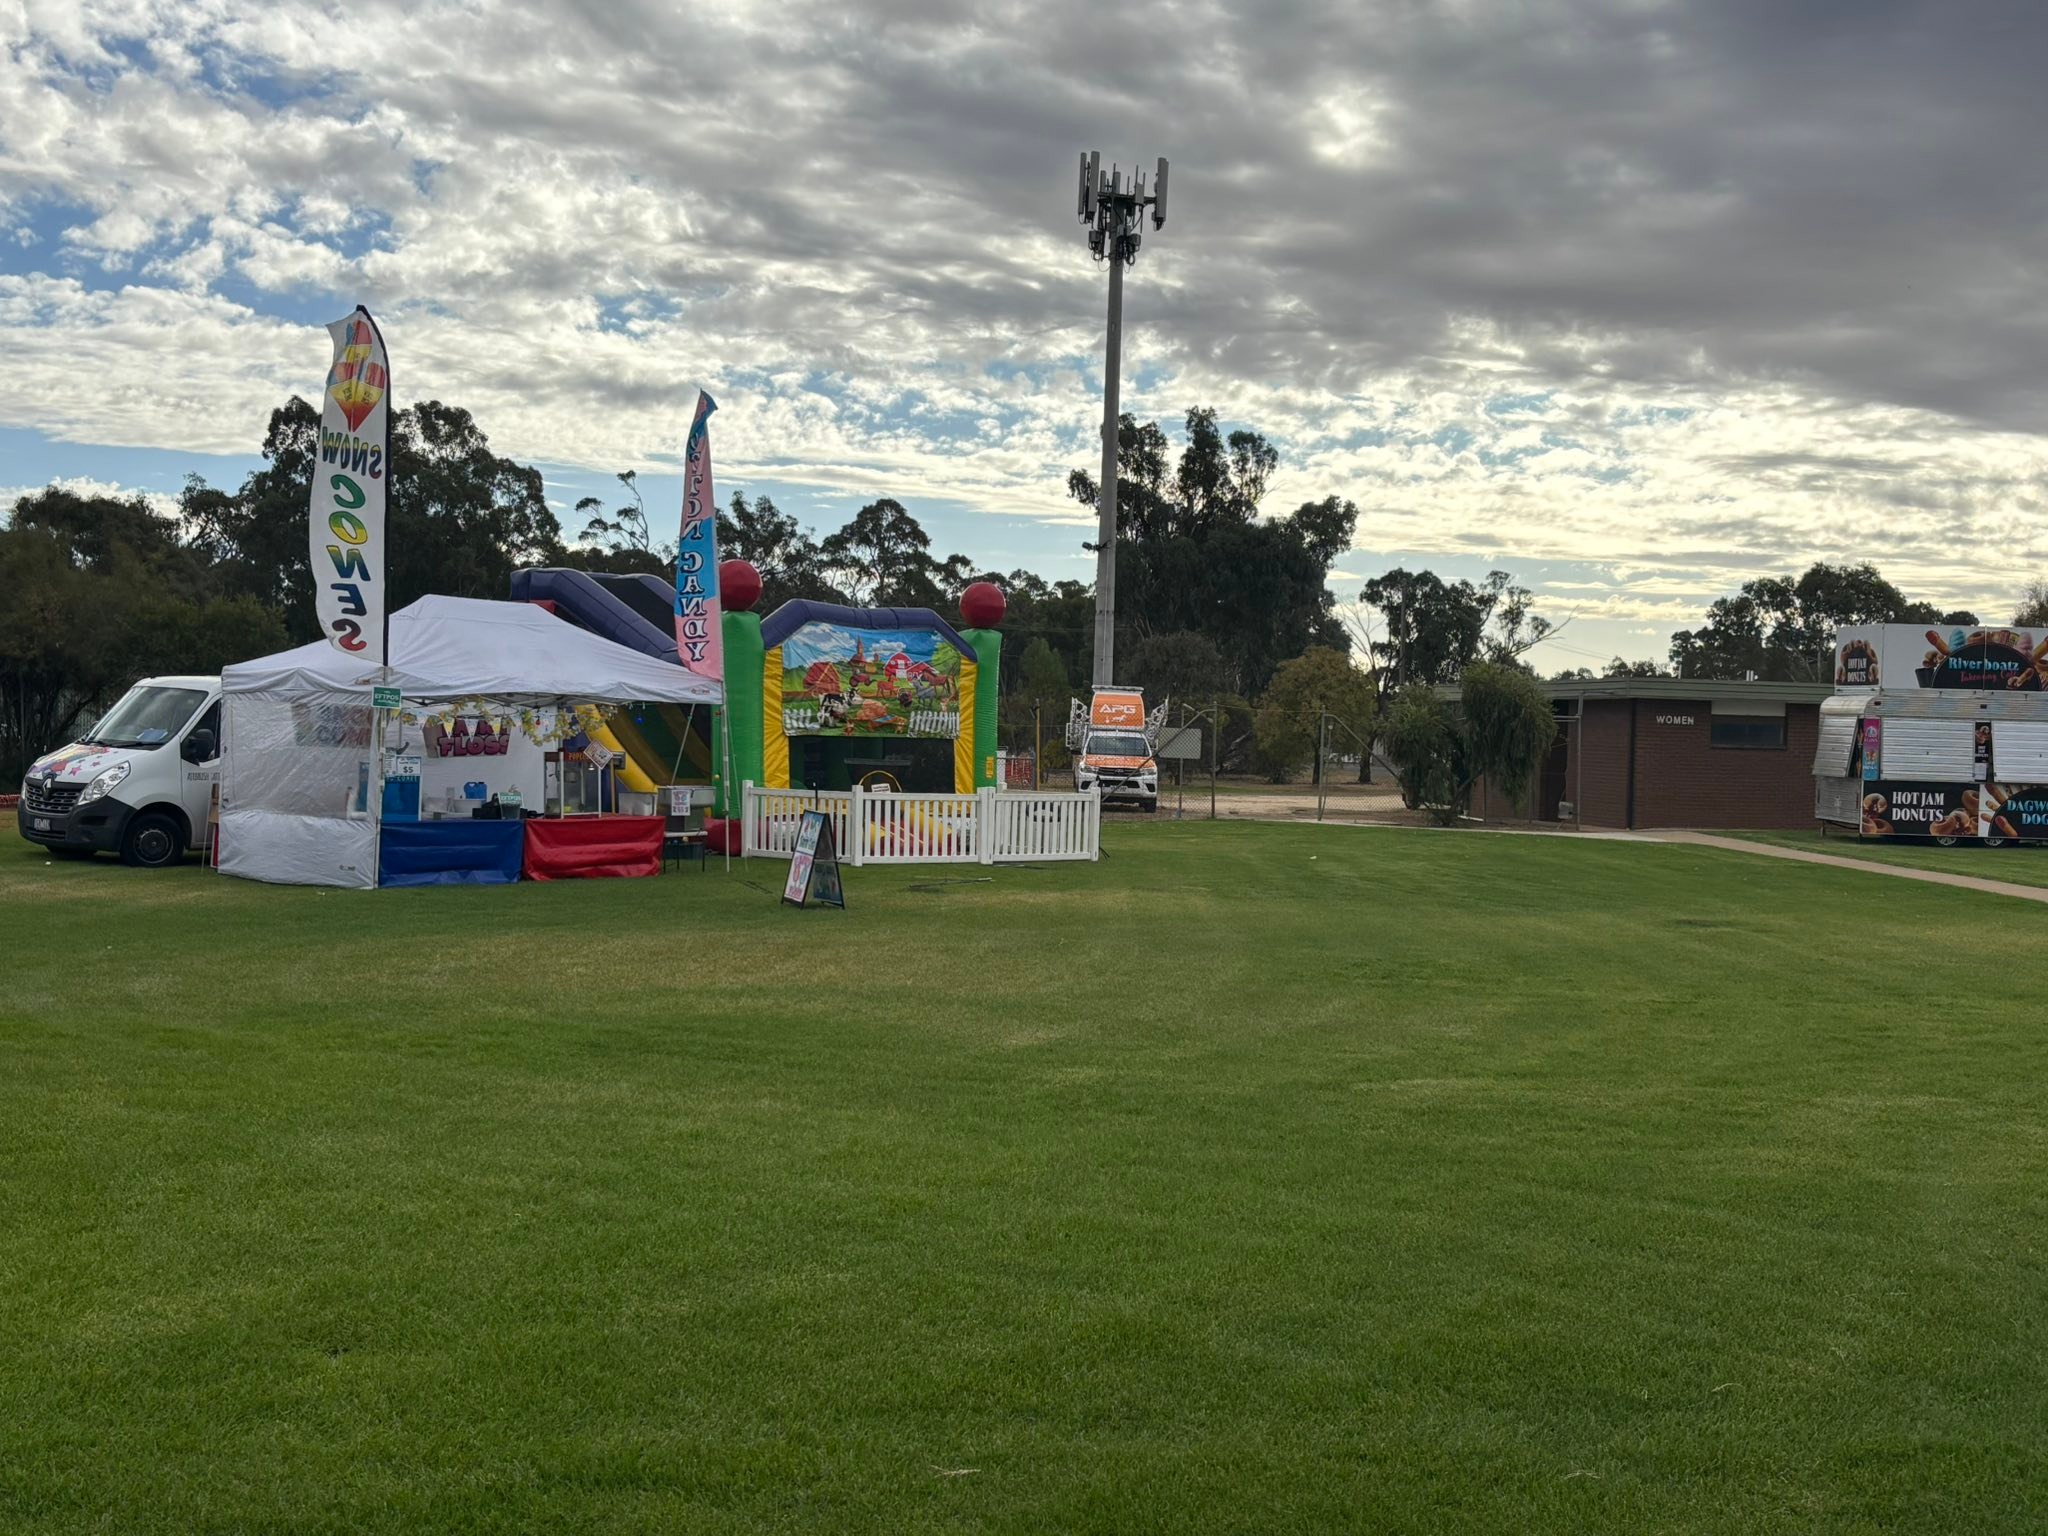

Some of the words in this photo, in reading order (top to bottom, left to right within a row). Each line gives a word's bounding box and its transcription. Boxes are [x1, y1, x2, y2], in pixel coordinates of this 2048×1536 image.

[1100, 704, 1136, 714] APG
[1656, 715, 1695, 725] WOMEN
[403, 766, 414, 774] $5
[1892, 791, 1920, 805] HOT
[1921, 792, 1945, 808] JAM
[2007, 800, 2048, 811] DAGW
[1892, 807, 1944, 822] DONUTS
